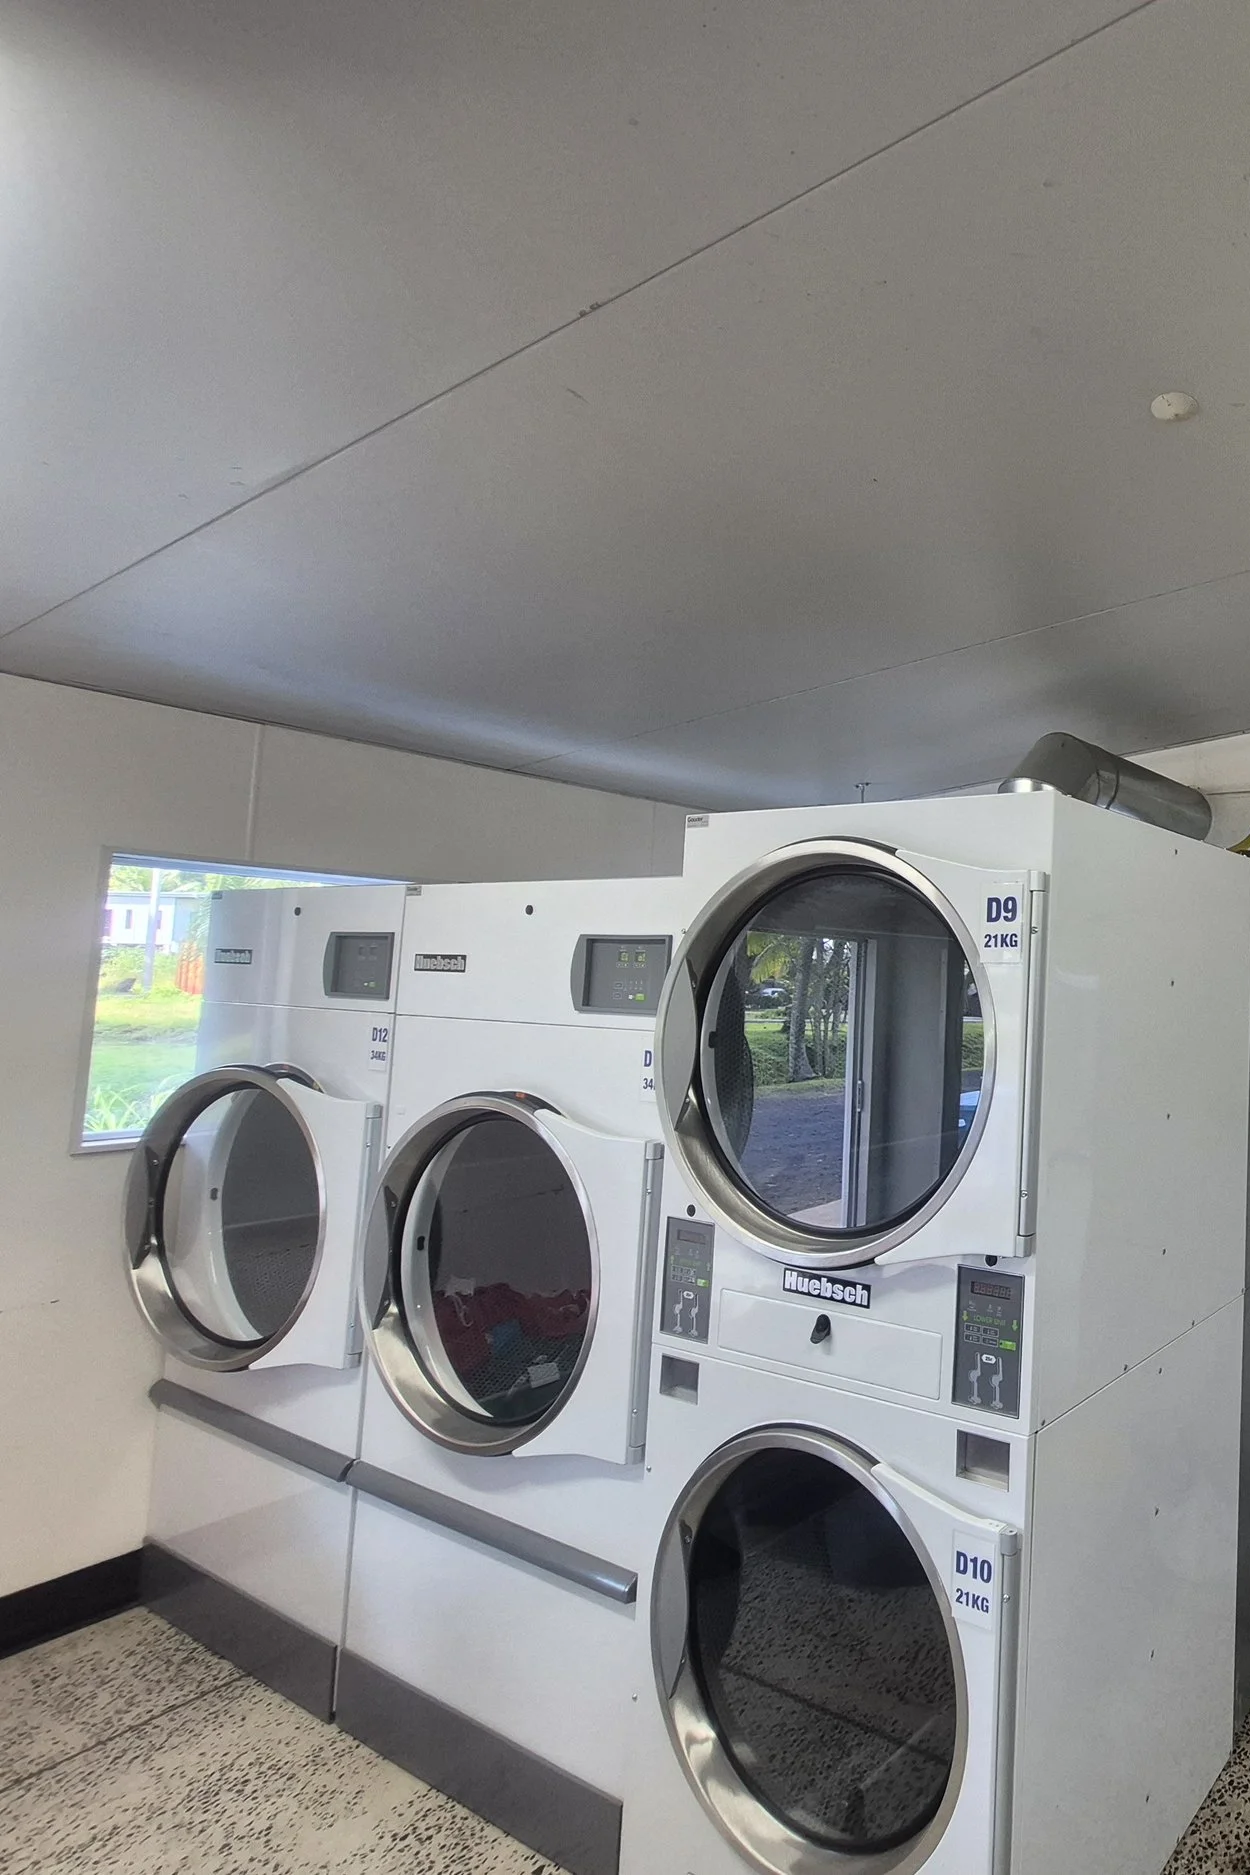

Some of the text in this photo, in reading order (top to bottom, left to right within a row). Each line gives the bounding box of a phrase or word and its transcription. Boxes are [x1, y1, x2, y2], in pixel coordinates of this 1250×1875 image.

[986, 896, 1018, 923] D9
[984, 933, 1018, 948] 21KG
[415, 955, 465, 971] Huebsch
[372, 1027, 388, 1043] D12
[644, 1050, 653, 1067] D
[642, 1077, 655, 1090] 34
[784, 1269, 868, 1306] Huebsch
[955, 1550, 993, 1584] D10
[955, 1587, 990, 1614] 21KG
